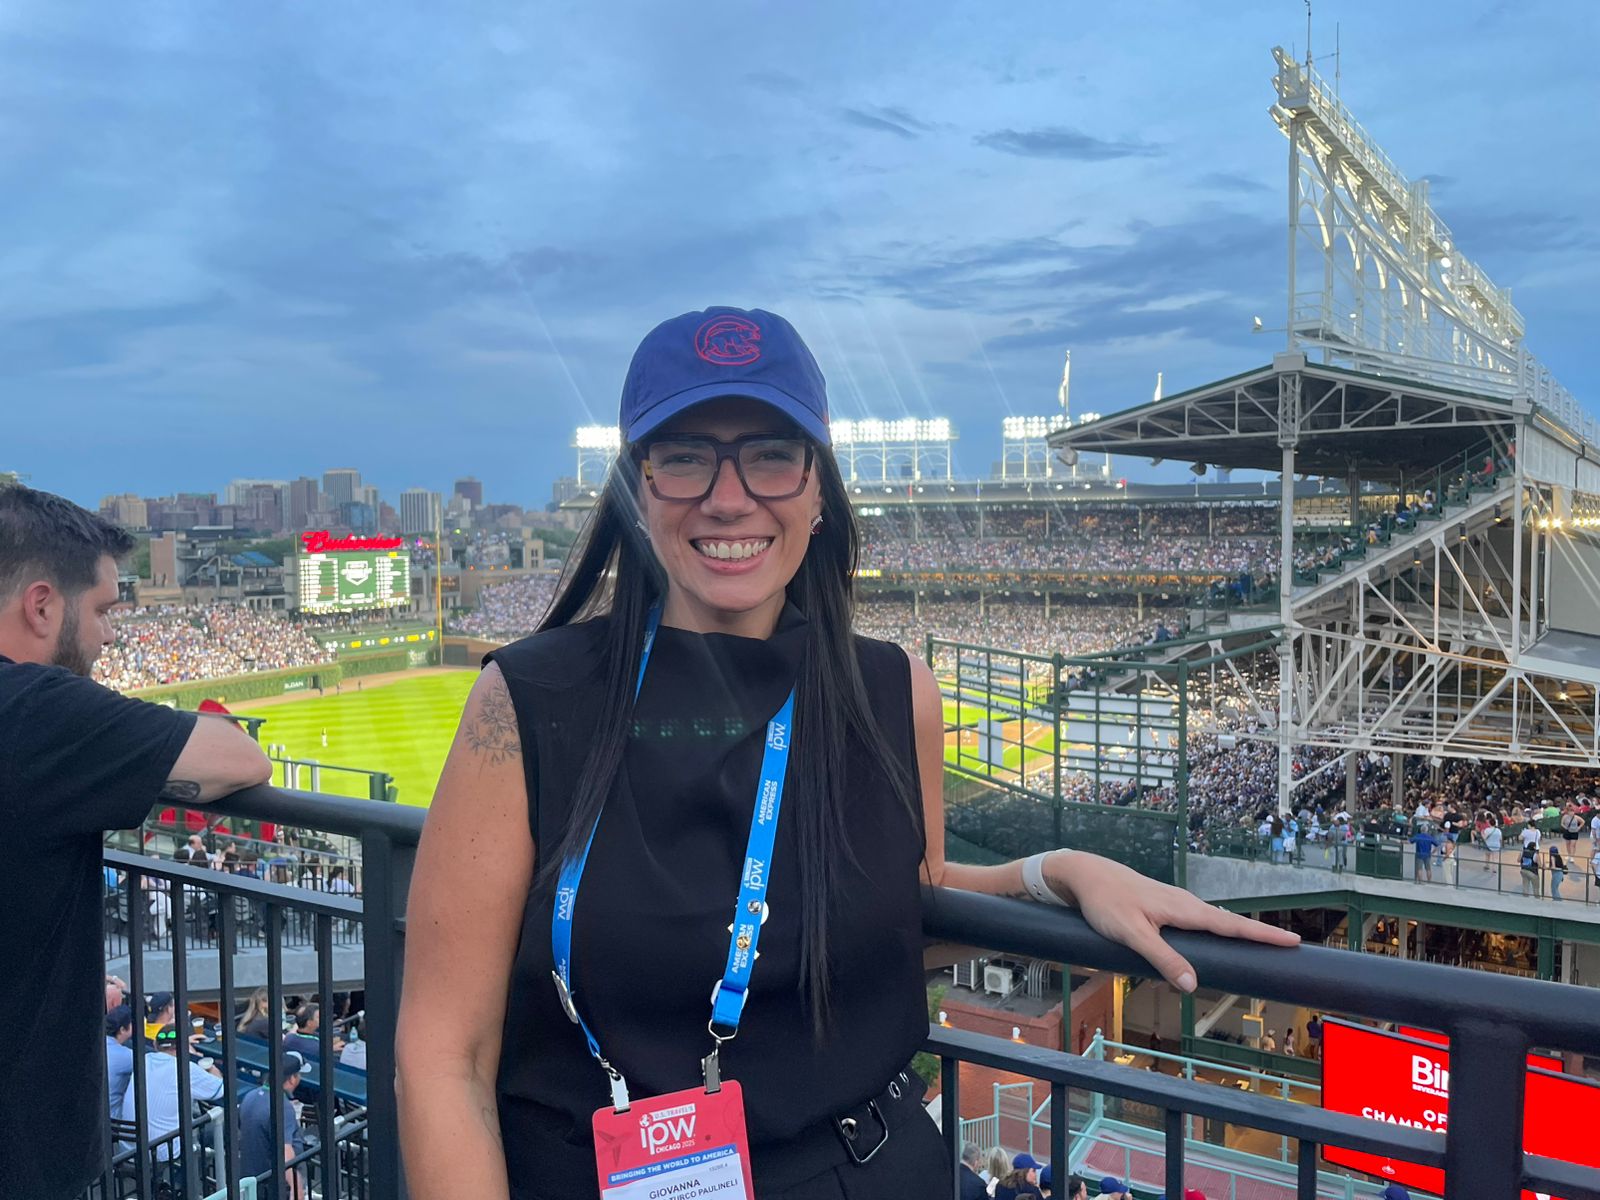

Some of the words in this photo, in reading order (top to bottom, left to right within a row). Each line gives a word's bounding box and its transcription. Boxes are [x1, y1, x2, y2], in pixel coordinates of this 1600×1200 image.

[758, 779, 771, 826] AMERICAN
[765, 781, 778, 821] EXPRESS
[656, 1142, 681, 1154] CHICAGO
[682, 1140, 695, 1149] 2025
[611, 1168, 646, 1182] BRINGING
[648, 1164, 662, 1173] THE
[663, 1158, 689, 1170] WORLD
[691, 1155, 701, 1163] TO
[702, 1148, 735, 1161] AMERICA
[649, 1179, 701, 1200] GIOVANNA
[698, 1178, 738, 1197] PAULINELI
